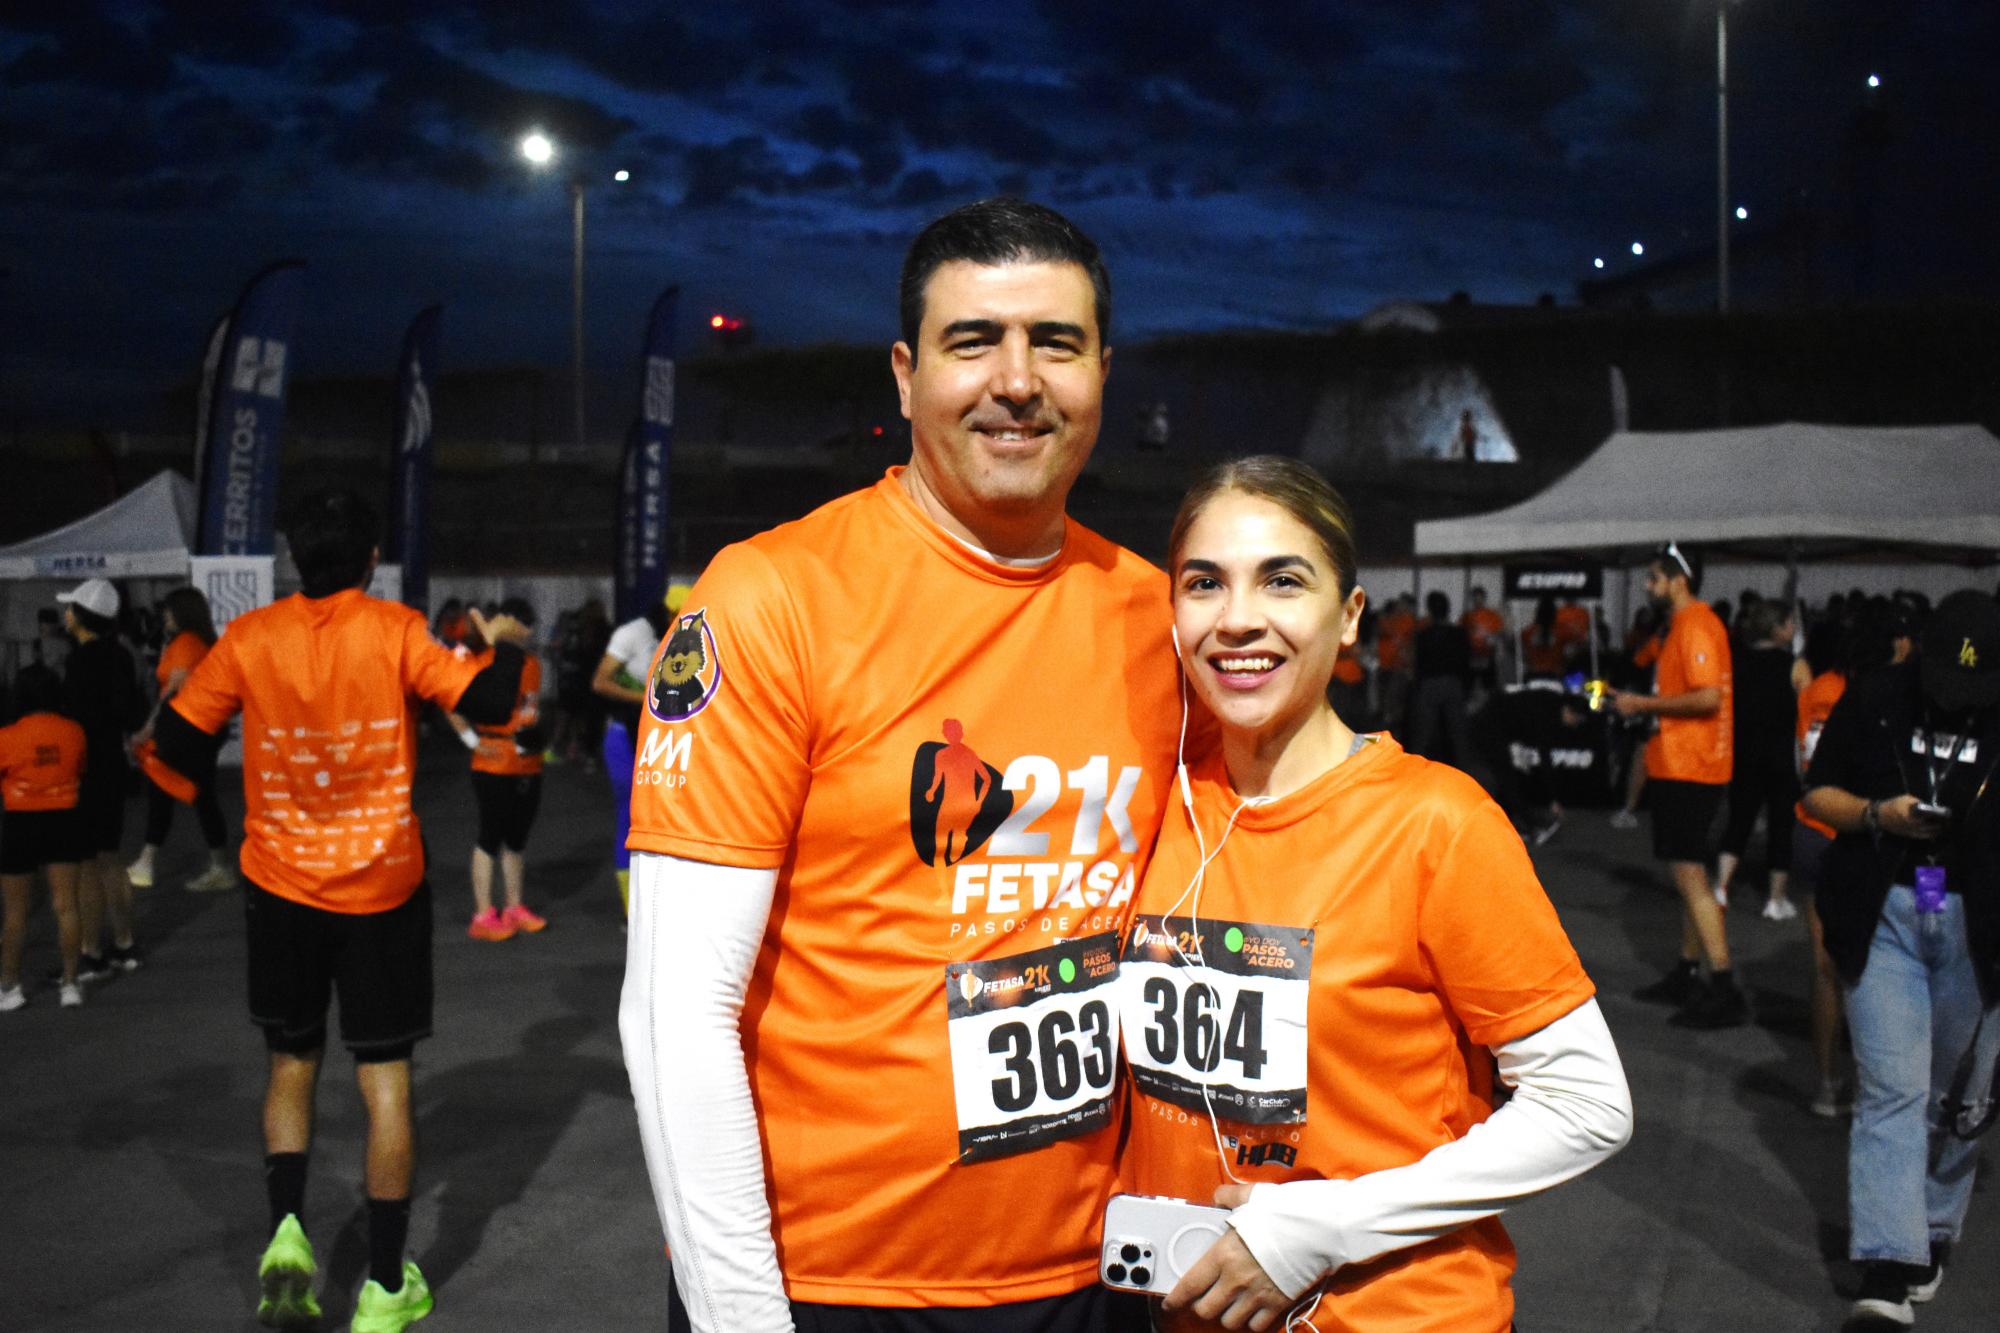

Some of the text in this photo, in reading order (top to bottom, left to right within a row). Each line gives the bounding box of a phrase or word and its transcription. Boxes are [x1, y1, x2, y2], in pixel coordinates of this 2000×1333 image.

[636, 770, 688, 789] GROUP
[986, 754, 1144, 857] 21K
[951, 861, 1136, 915] FETASA
[949, 914, 1121, 938] PASOS DE ACER
[1083, 952, 1112, 969] PASOS
[1242, 943, 1288, 957] PASOS
[1248, 955, 1295, 969] ACERO
[984, 975, 1025, 994] FETASA
[1024, 964, 1052, 991] 21K
[1089, 961, 1117, 979] ACERO
[1143, 976, 1268, 1081] 364
[987, 1000, 1113, 1112] 363
[1150, 1102, 1199, 1127] PASOS
